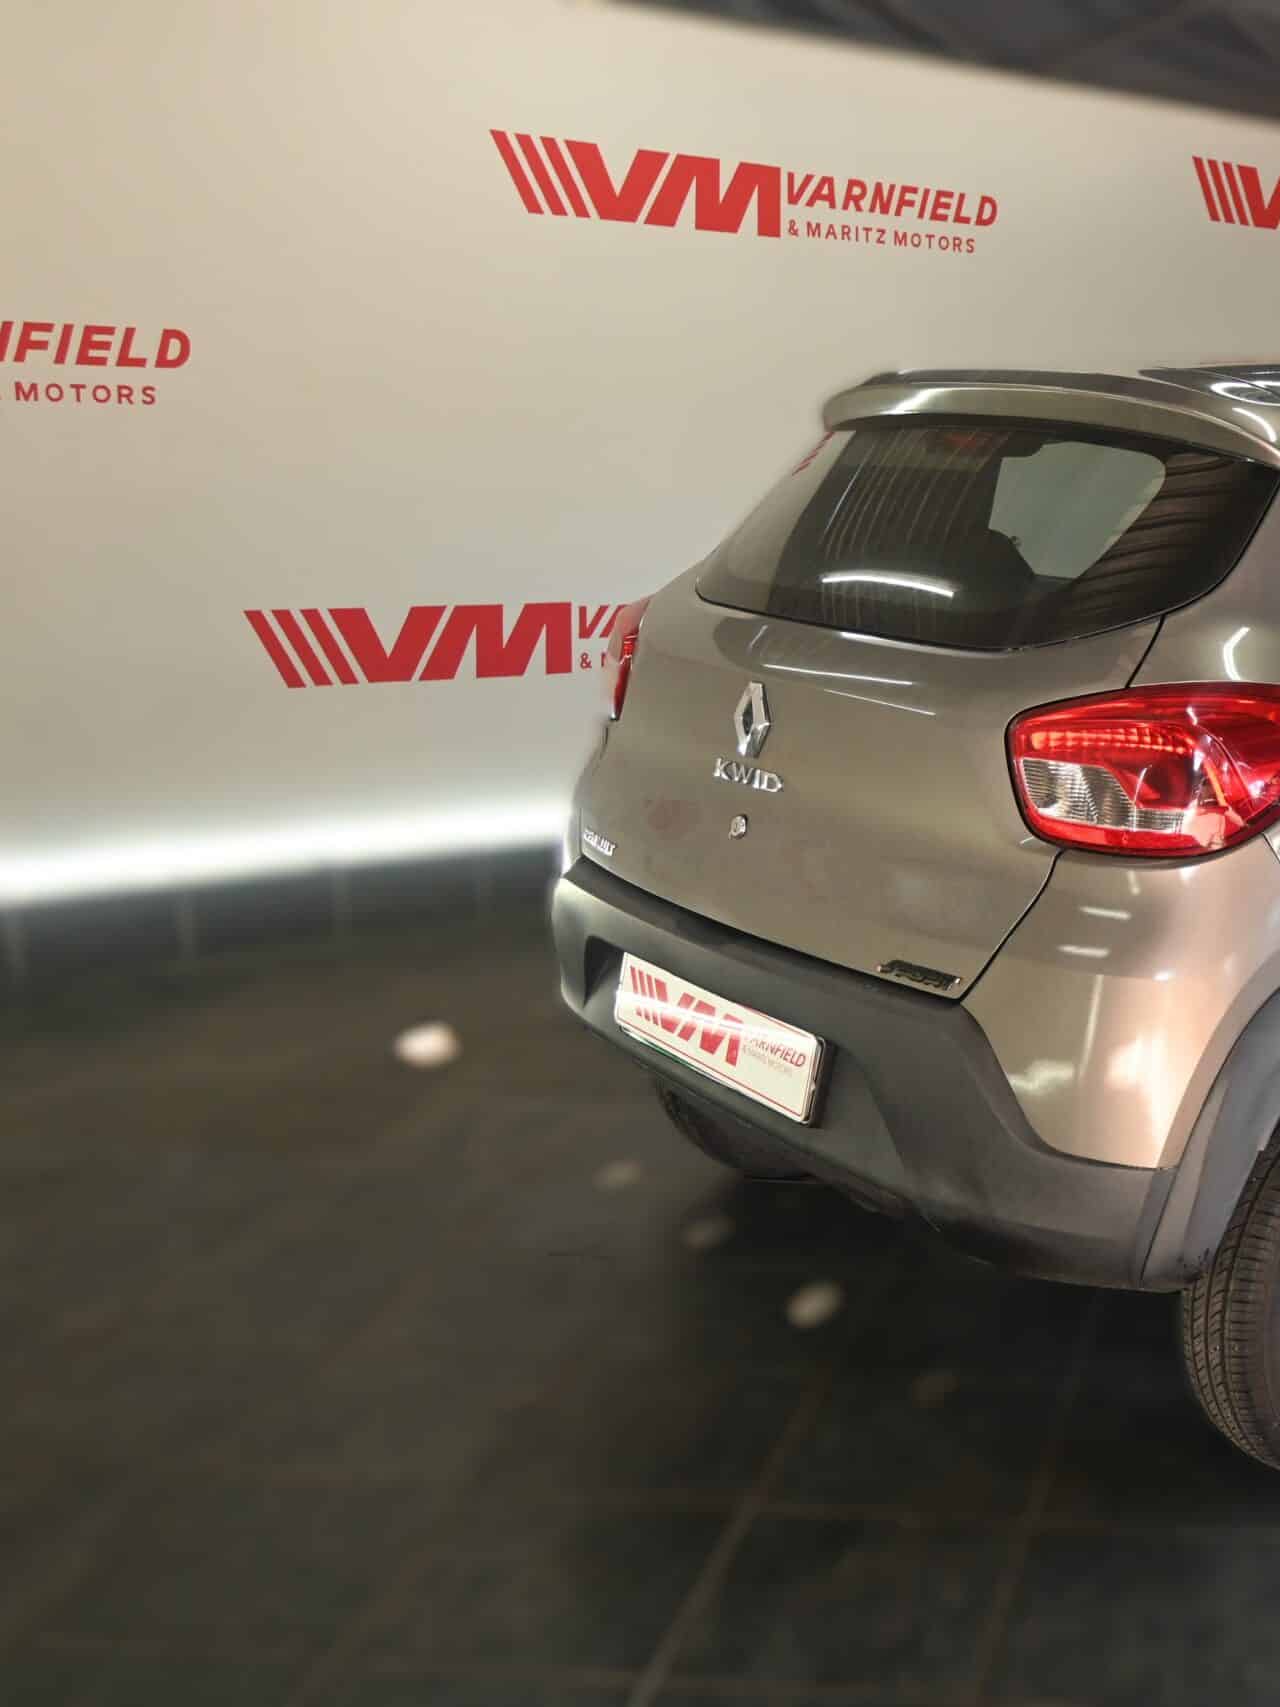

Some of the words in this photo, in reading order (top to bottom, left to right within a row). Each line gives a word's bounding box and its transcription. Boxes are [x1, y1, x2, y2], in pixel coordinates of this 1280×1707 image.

[563, 139, 781, 238] VM
[787, 171, 998, 227] VARNFIELD
[787, 219, 799, 237] &
[806, 221, 887, 245] MARITZ
[894, 230, 976, 254] MOTORS
[14, 381, 157, 406] MOTORS
[327, 602, 573, 684] VM
[580, 652, 592, 669] &
[713, 757, 784, 793] KWID
